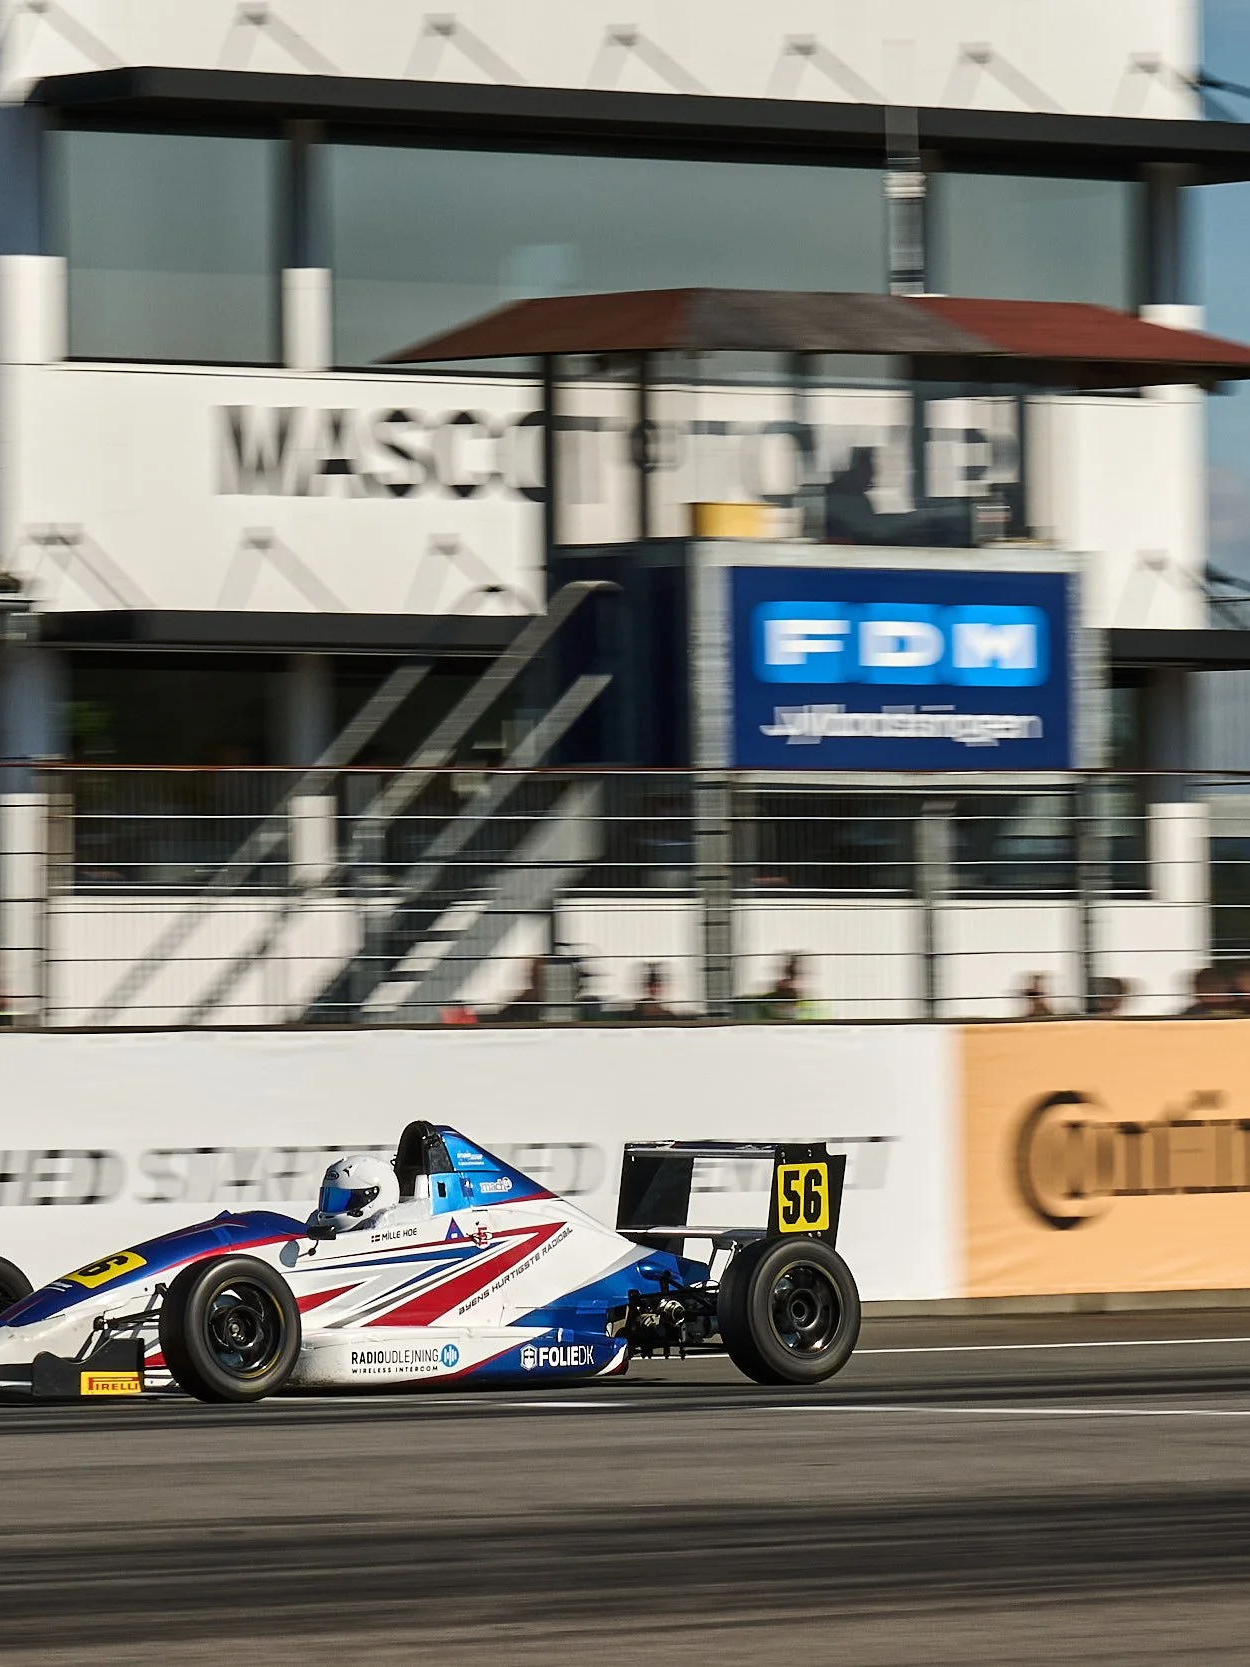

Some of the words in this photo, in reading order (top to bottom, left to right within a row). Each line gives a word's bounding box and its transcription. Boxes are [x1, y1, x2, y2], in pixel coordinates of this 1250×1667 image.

[763, 619, 1038, 669] FDM
[1004, 1088, 1250, 1231] Conti
[782, 1168, 823, 1225] 56
[491, 1253, 541, 1292] HURTIGSTE
[351, 1348, 439, 1365] RADIOUDLEJNING
[538, 1345, 595, 1367] FOLIEDK
[88, 1376, 140, 1391] PIRELLI
